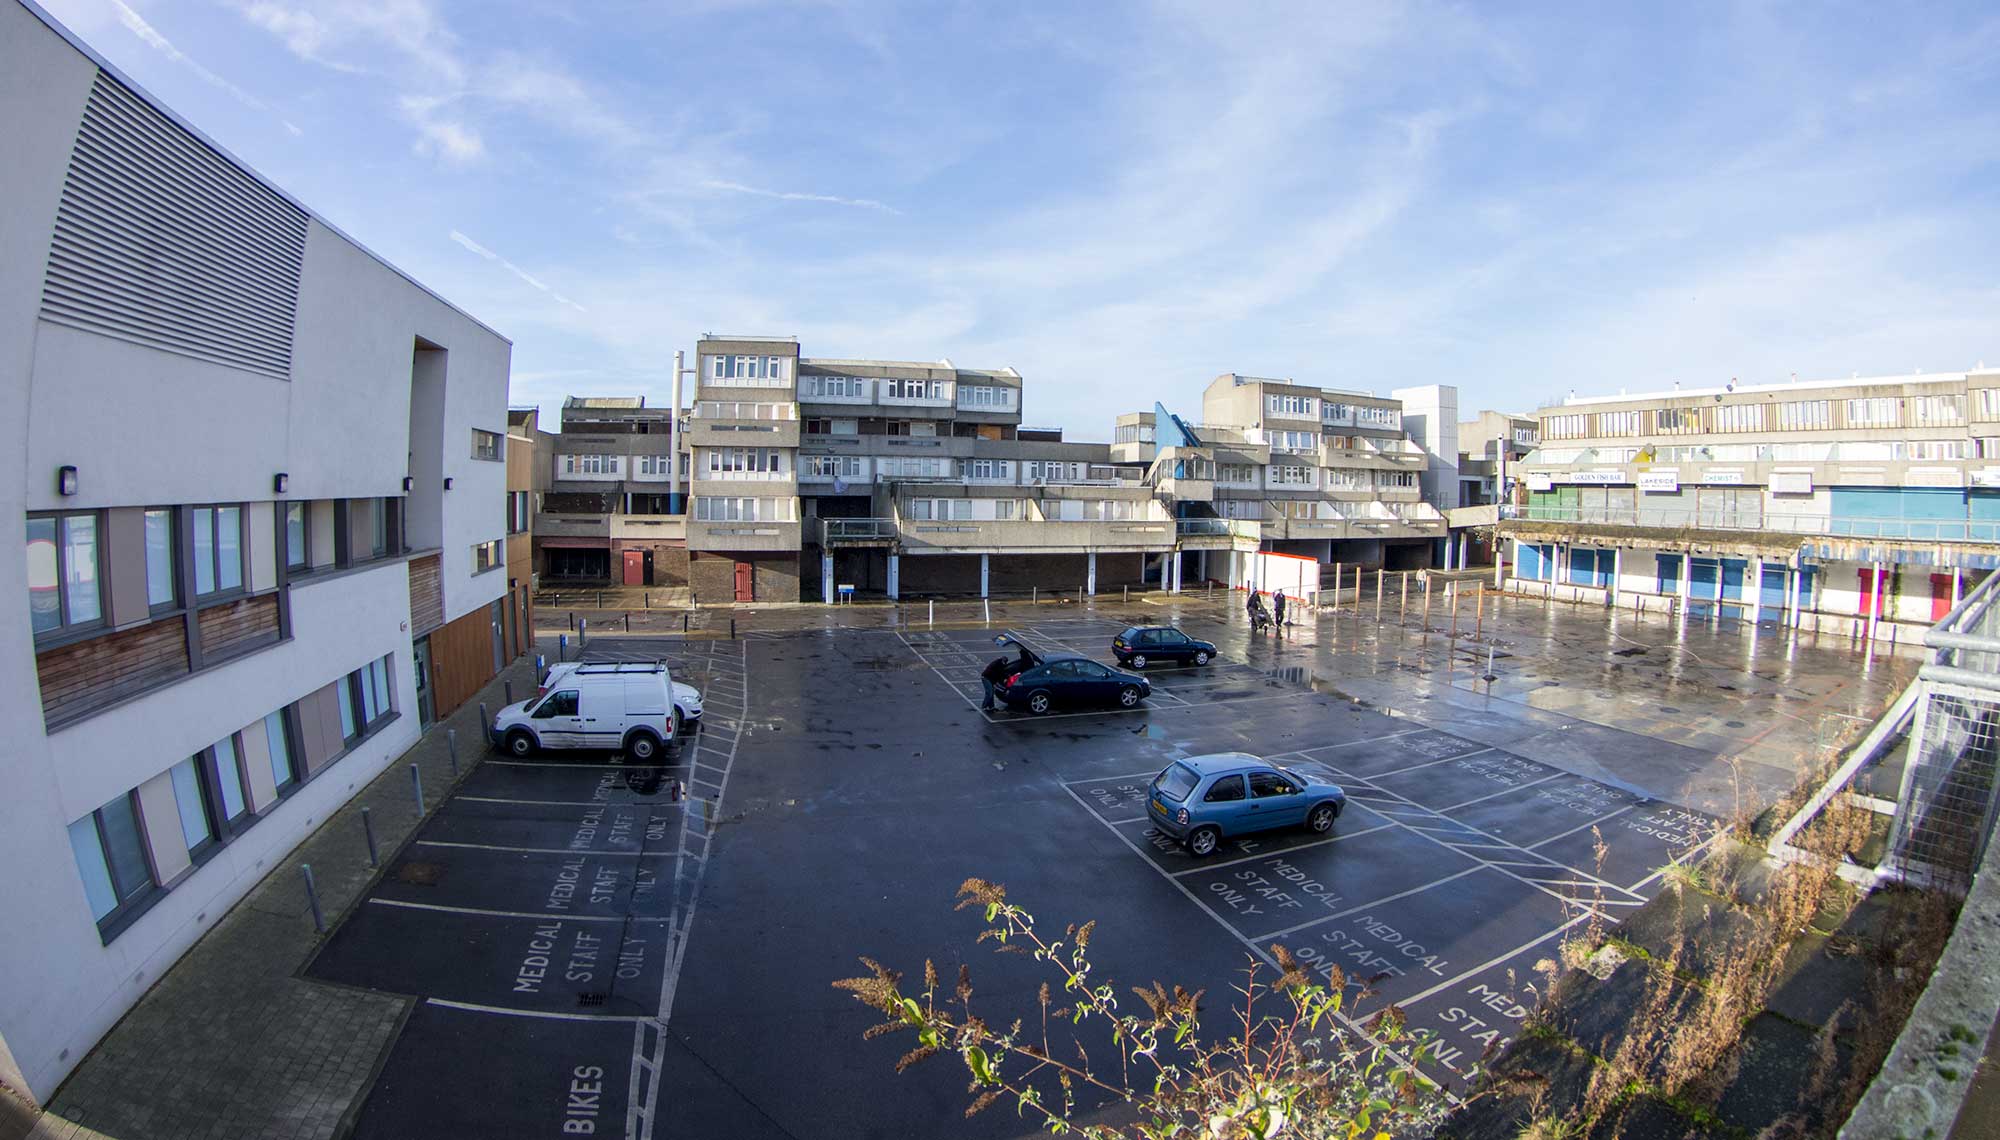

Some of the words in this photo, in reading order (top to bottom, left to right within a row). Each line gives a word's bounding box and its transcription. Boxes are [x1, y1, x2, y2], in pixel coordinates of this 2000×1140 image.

[1089, 788, 1128, 808] ONLY
[1660, 809, 1708, 826] ONLY
[571, 808, 605, 848] MEDICAL
[646, 815, 668, 840] ONLY
[1619, 818, 1693, 847] MEDICAL
[547, 857, 586, 910] MEDICAL
[590, 866, 619, 905] STAFF
[1209, 882, 1264, 916] ONLY
[1235, 871, 1303, 910] STAFF
[1264, 858, 1345, 909] MEDICAL
[513, 922, 562, 993] MEDICAL
[565, 931, 603, 983] STAFF
[616, 936, 647, 979] ONLY
[1322, 930, 1406, 978] STAFF
[1353, 915, 1453, 977] MEDICAL
[1438, 1007, 1510, 1049] STA
[563, 1065, 603, 1135] BIKES
